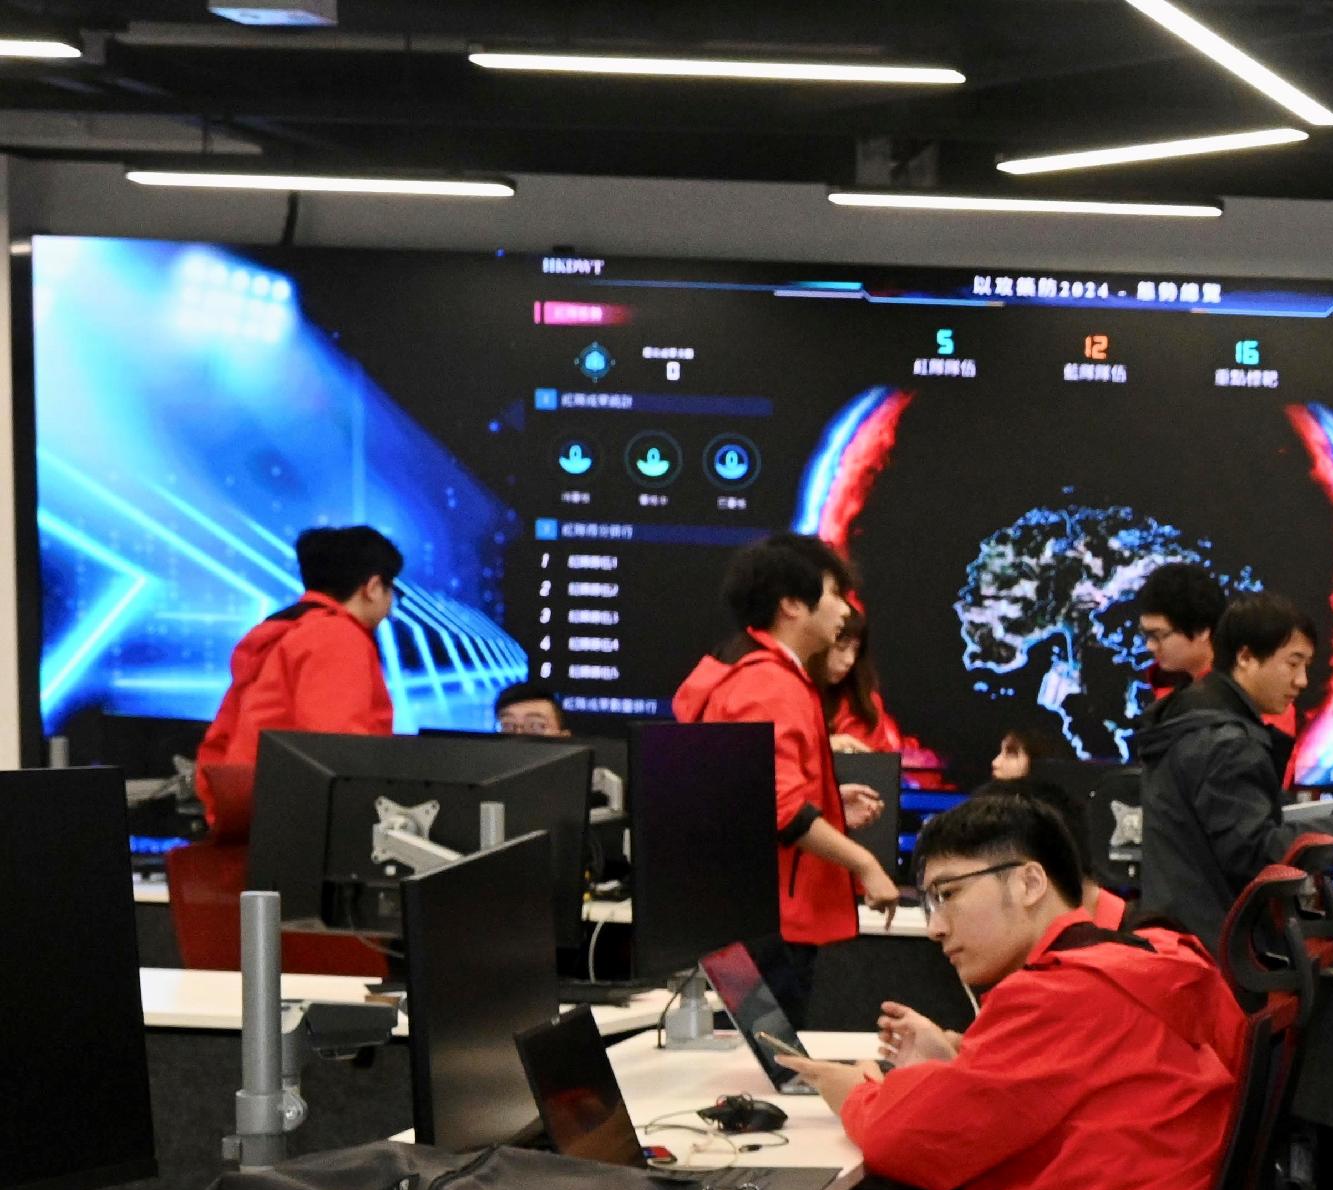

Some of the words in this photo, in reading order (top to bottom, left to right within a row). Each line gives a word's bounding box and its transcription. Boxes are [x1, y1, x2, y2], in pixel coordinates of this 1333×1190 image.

[936, 329, 954, 354] 5
[1084, 335, 1108, 359] 12
[1235, 340, 1259, 364] 16
